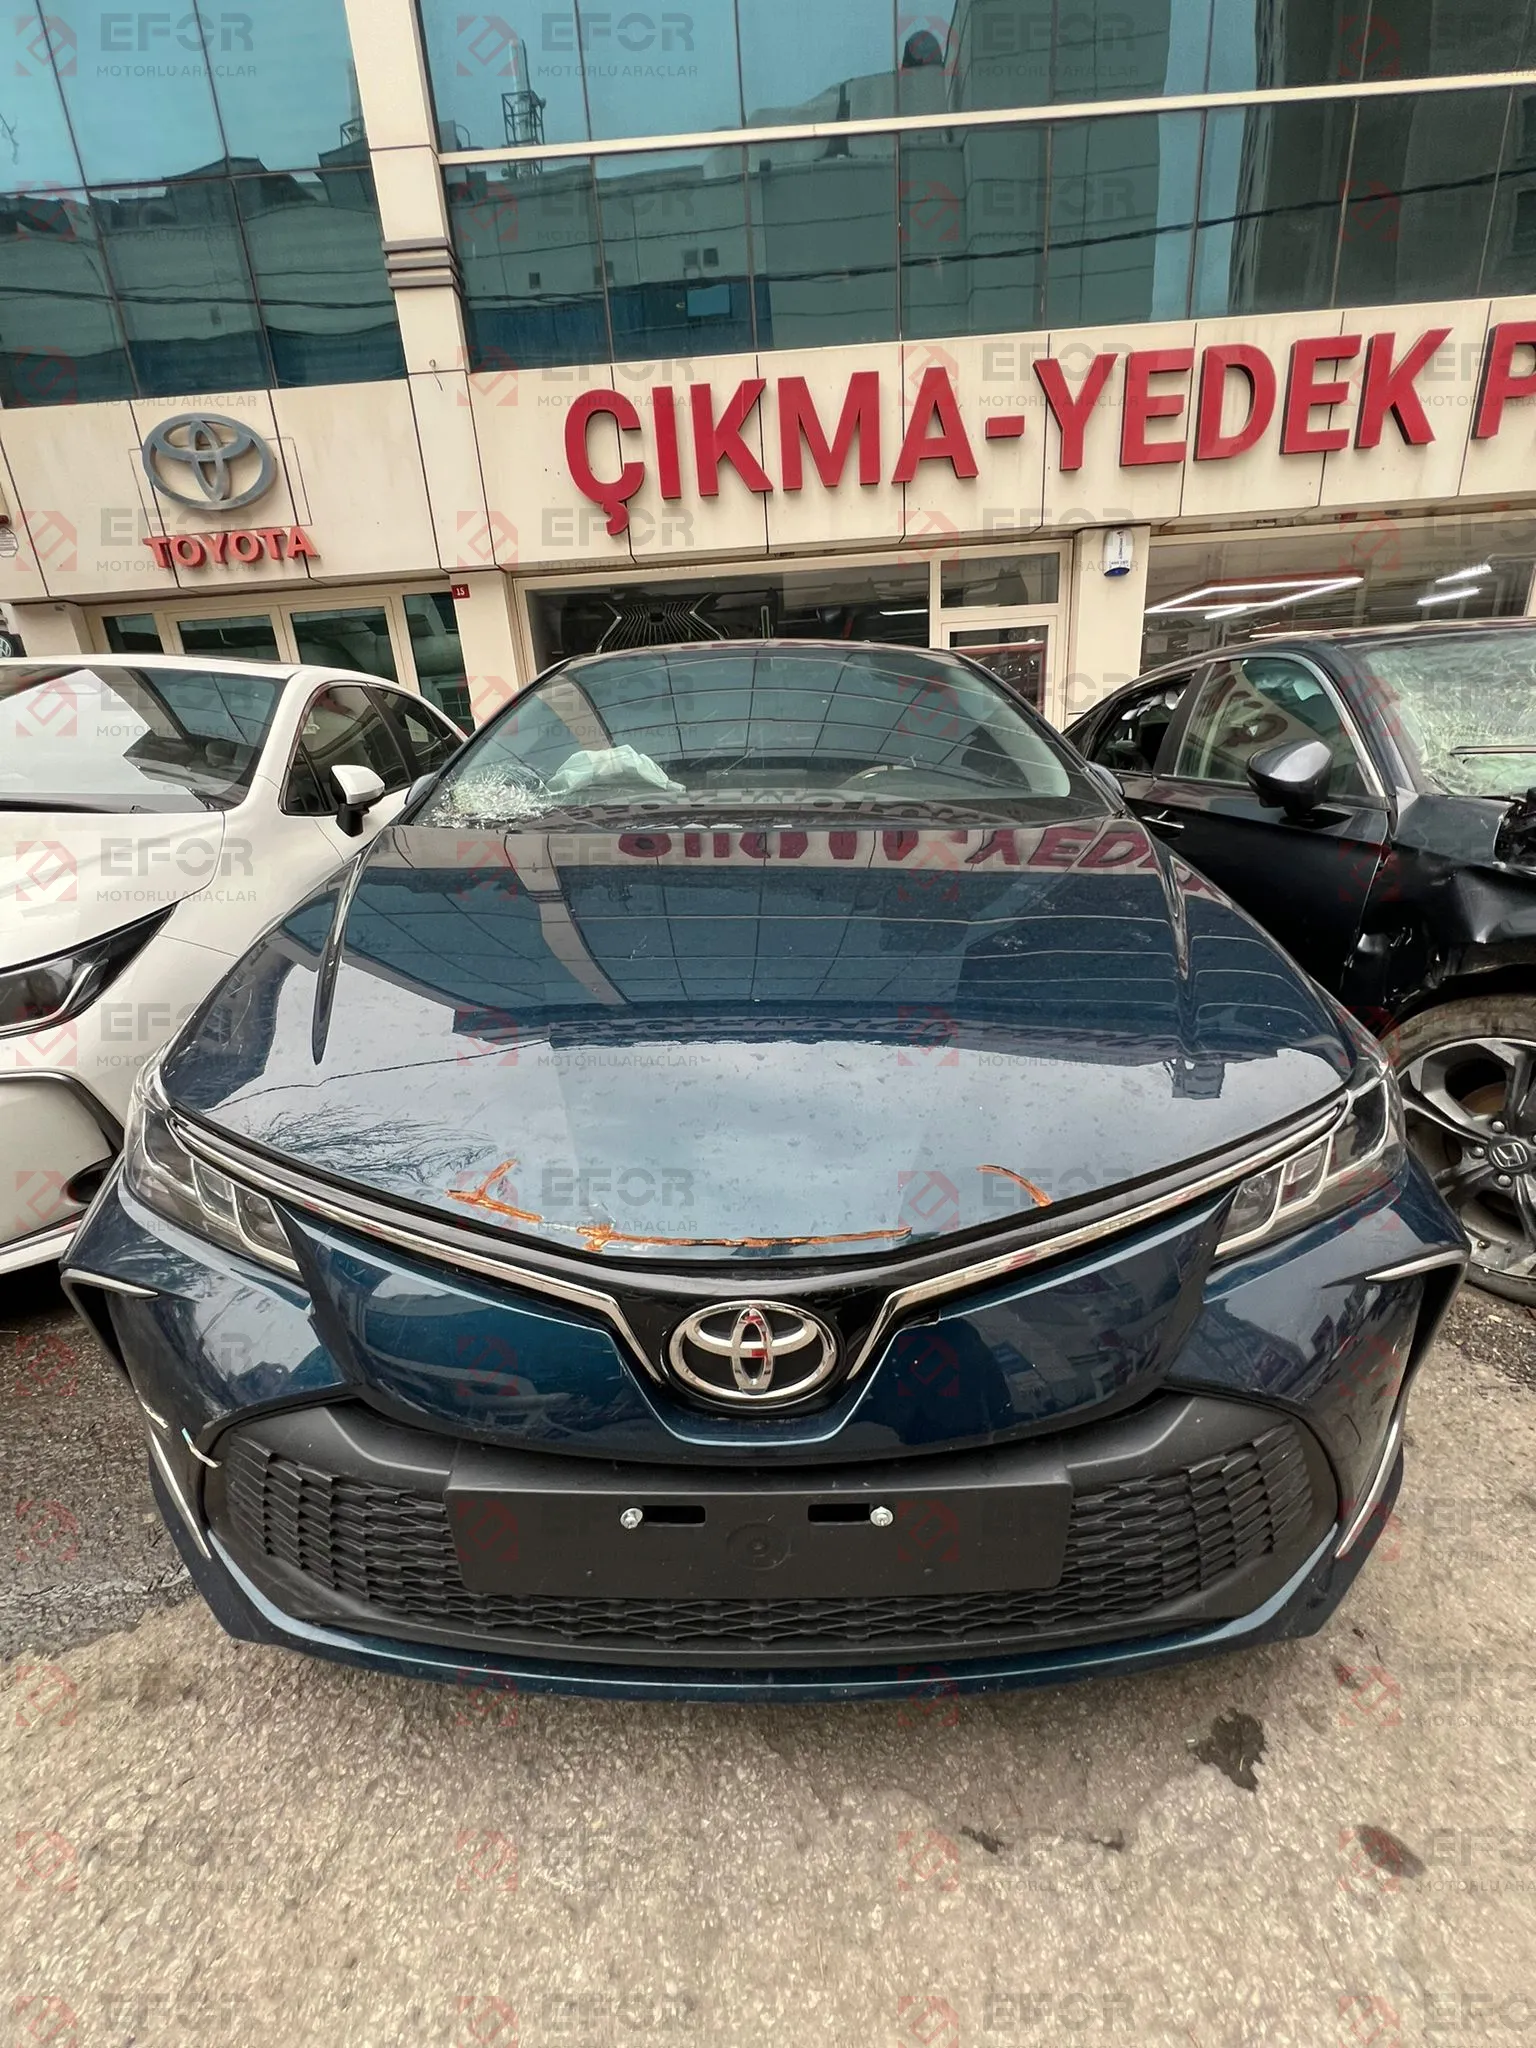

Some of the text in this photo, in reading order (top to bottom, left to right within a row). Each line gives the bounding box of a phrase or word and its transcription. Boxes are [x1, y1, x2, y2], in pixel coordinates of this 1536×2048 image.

[564, 327, 1454, 536] ÇIKMA-YEDEK
[143, 526, 318, 569] TOYOTA
[456, 587, 466, 596] 15
